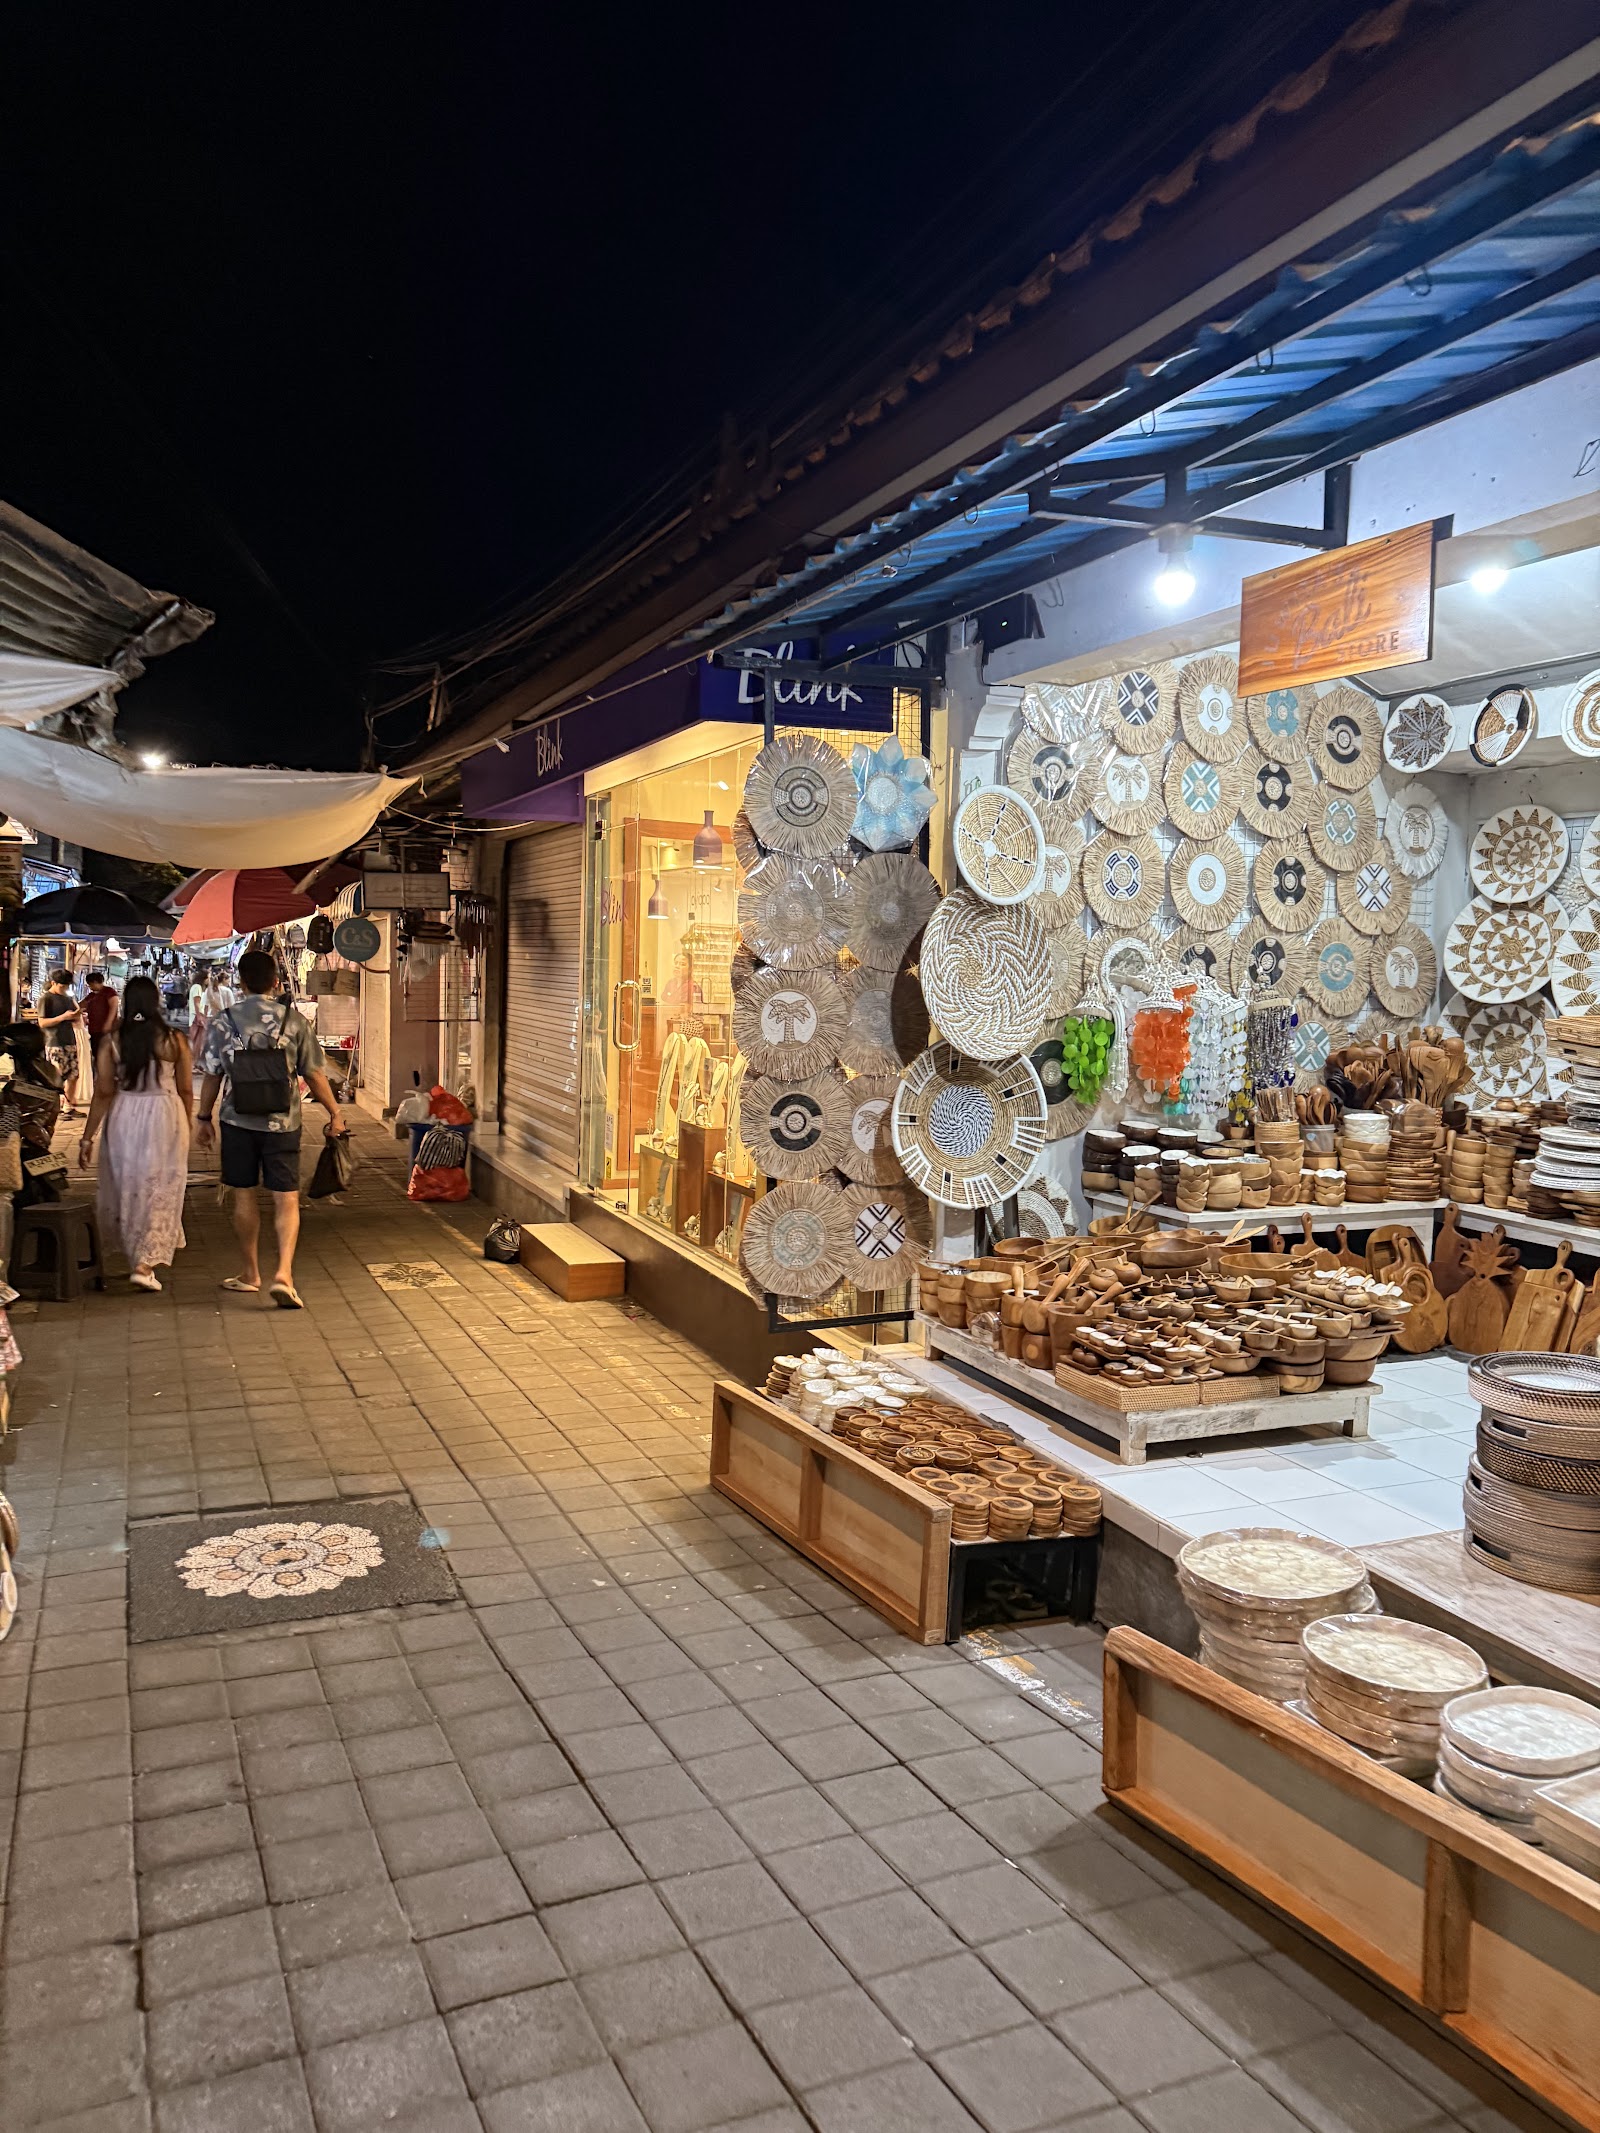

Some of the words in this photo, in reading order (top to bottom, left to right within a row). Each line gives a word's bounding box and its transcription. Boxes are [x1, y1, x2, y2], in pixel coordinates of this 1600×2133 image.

[1336, 631, 1400, 663] STORE
[535, 718, 564, 777] Blink
[601, 880, 628, 927] Blink
[341, 927, 375, 947] C&S
